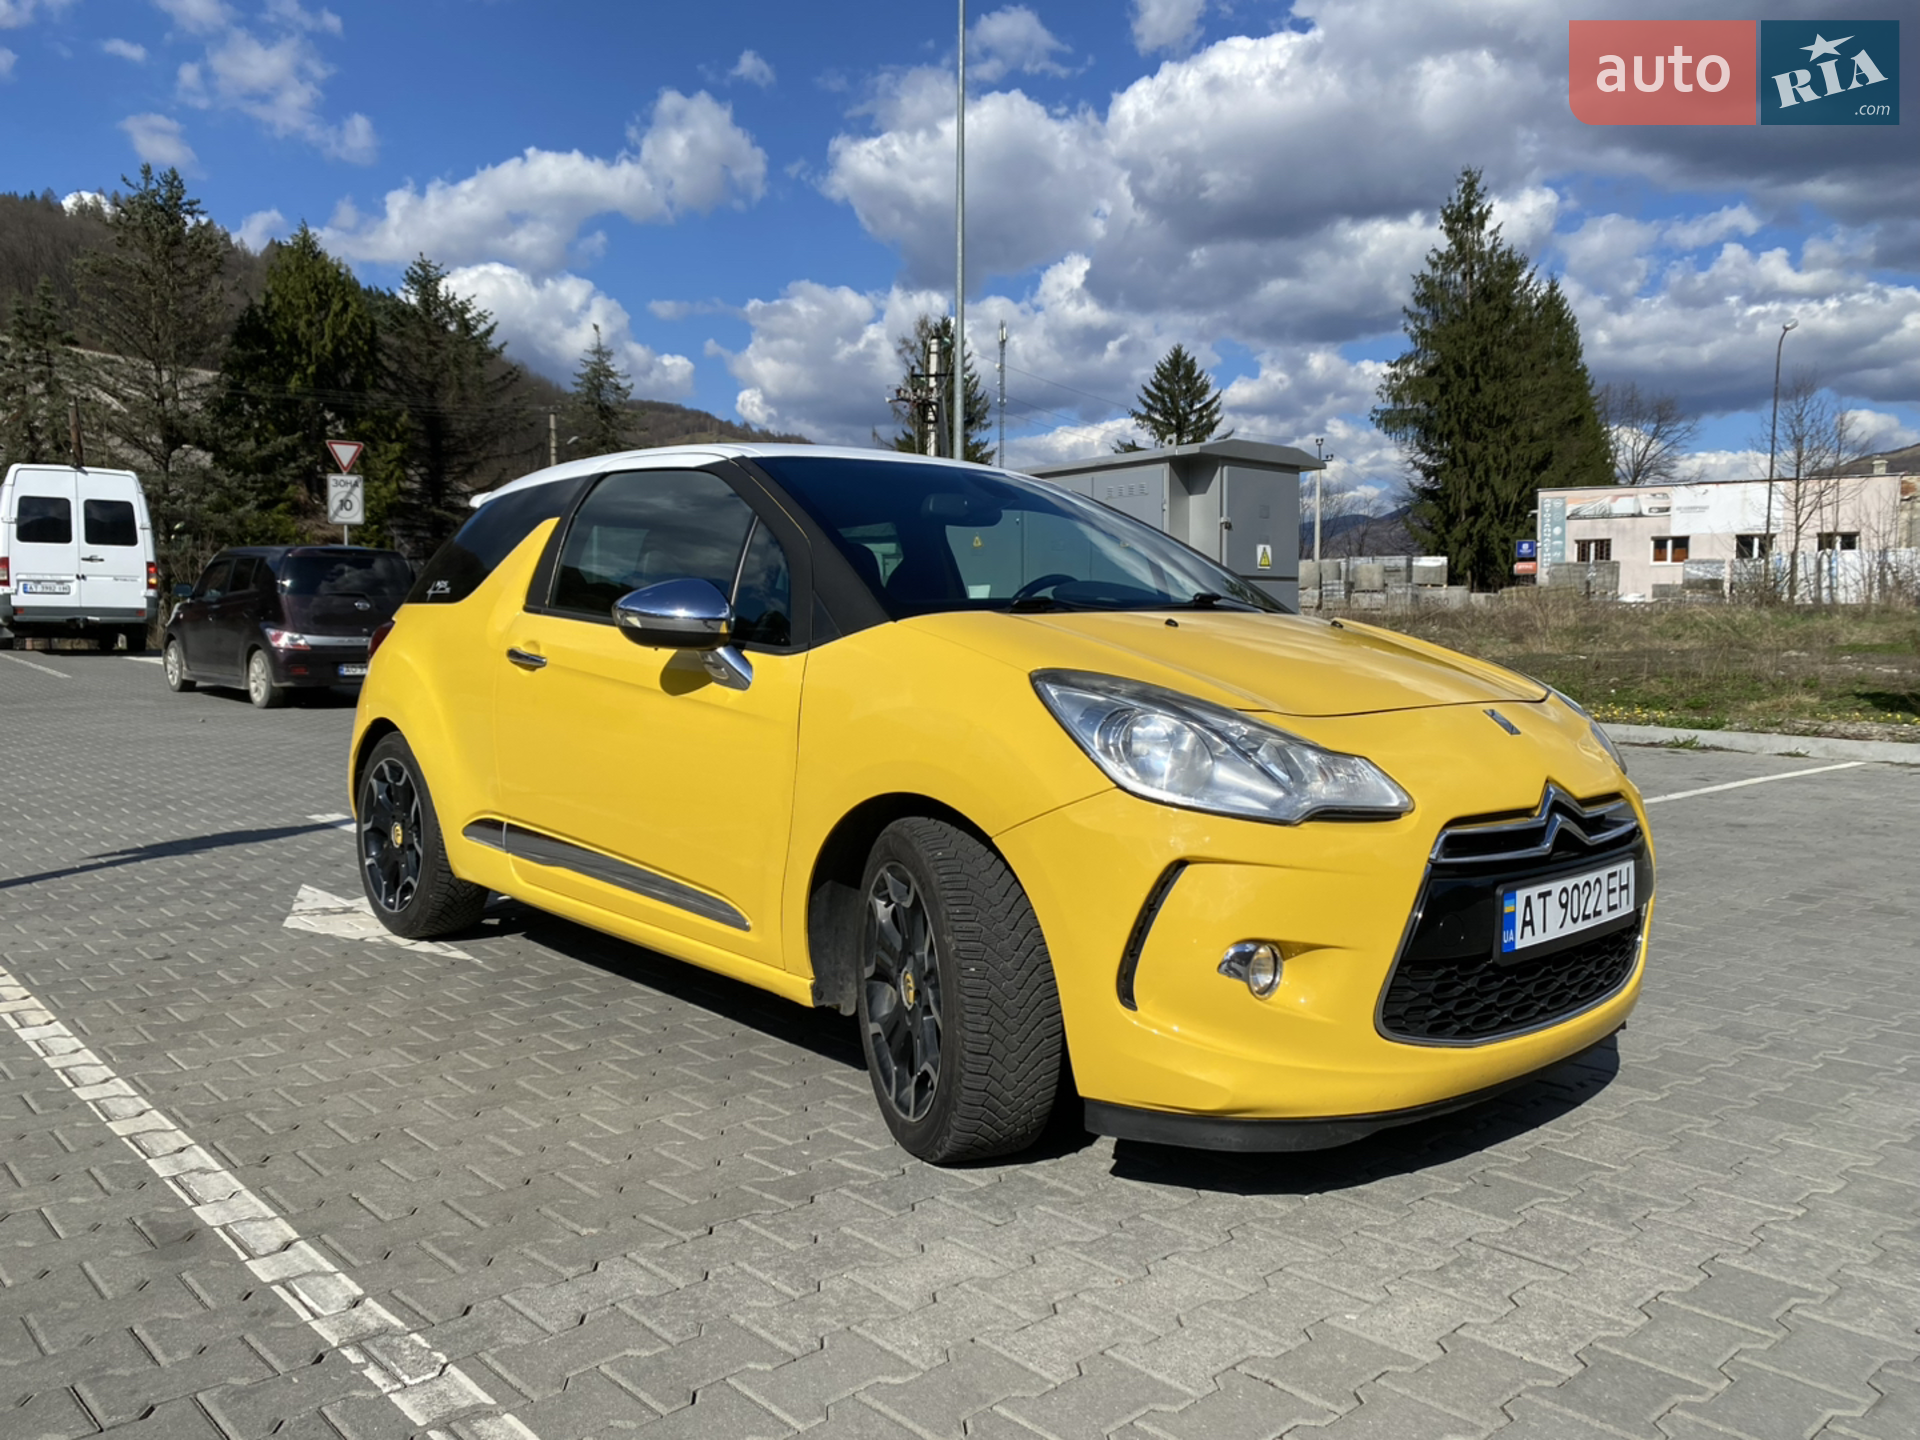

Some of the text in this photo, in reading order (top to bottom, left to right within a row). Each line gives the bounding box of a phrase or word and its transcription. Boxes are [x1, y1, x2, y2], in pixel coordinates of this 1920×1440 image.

[332, 478, 360, 488] ЗОНА
[339, 498, 353, 512] 10
[1520, 866, 1630, 940] AT 9022 EH
[1503, 929, 1514, 943] UA
